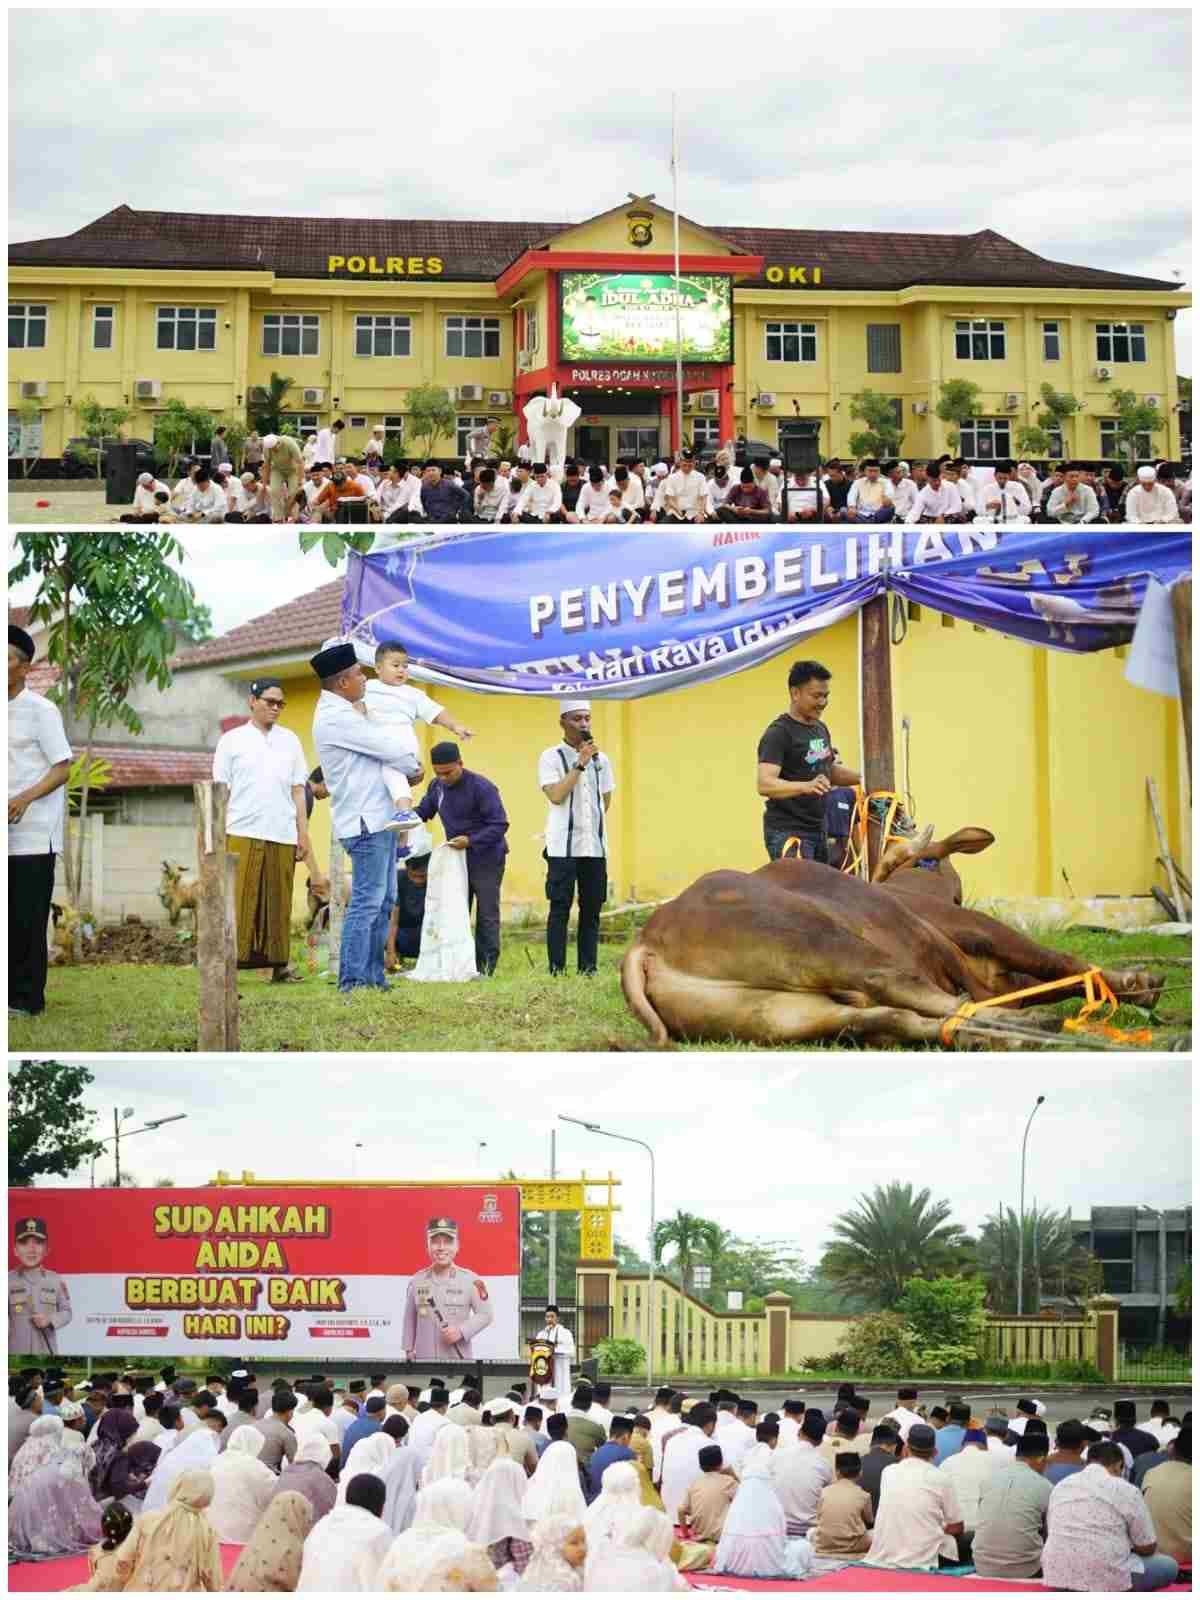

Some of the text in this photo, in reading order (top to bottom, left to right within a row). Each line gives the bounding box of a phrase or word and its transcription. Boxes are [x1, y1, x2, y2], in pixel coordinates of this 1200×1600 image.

[328, 255, 443, 274] POLRES
[767, 266, 821, 284] OKI
[571, 369, 611, 382] POLRES
[529, 531, 1001, 635] PENYEMBELIHAN
[586, 649, 646, 681] Hari
[651, 635, 728, 671] Raya
[154, 1205, 329, 1235] SUDAHKAH
[195, 1239, 285, 1270] ANDA
[126, 1277, 345, 1307] BERBUAT BAIK
[184, 1315, 289, 1337] HARI INI?
